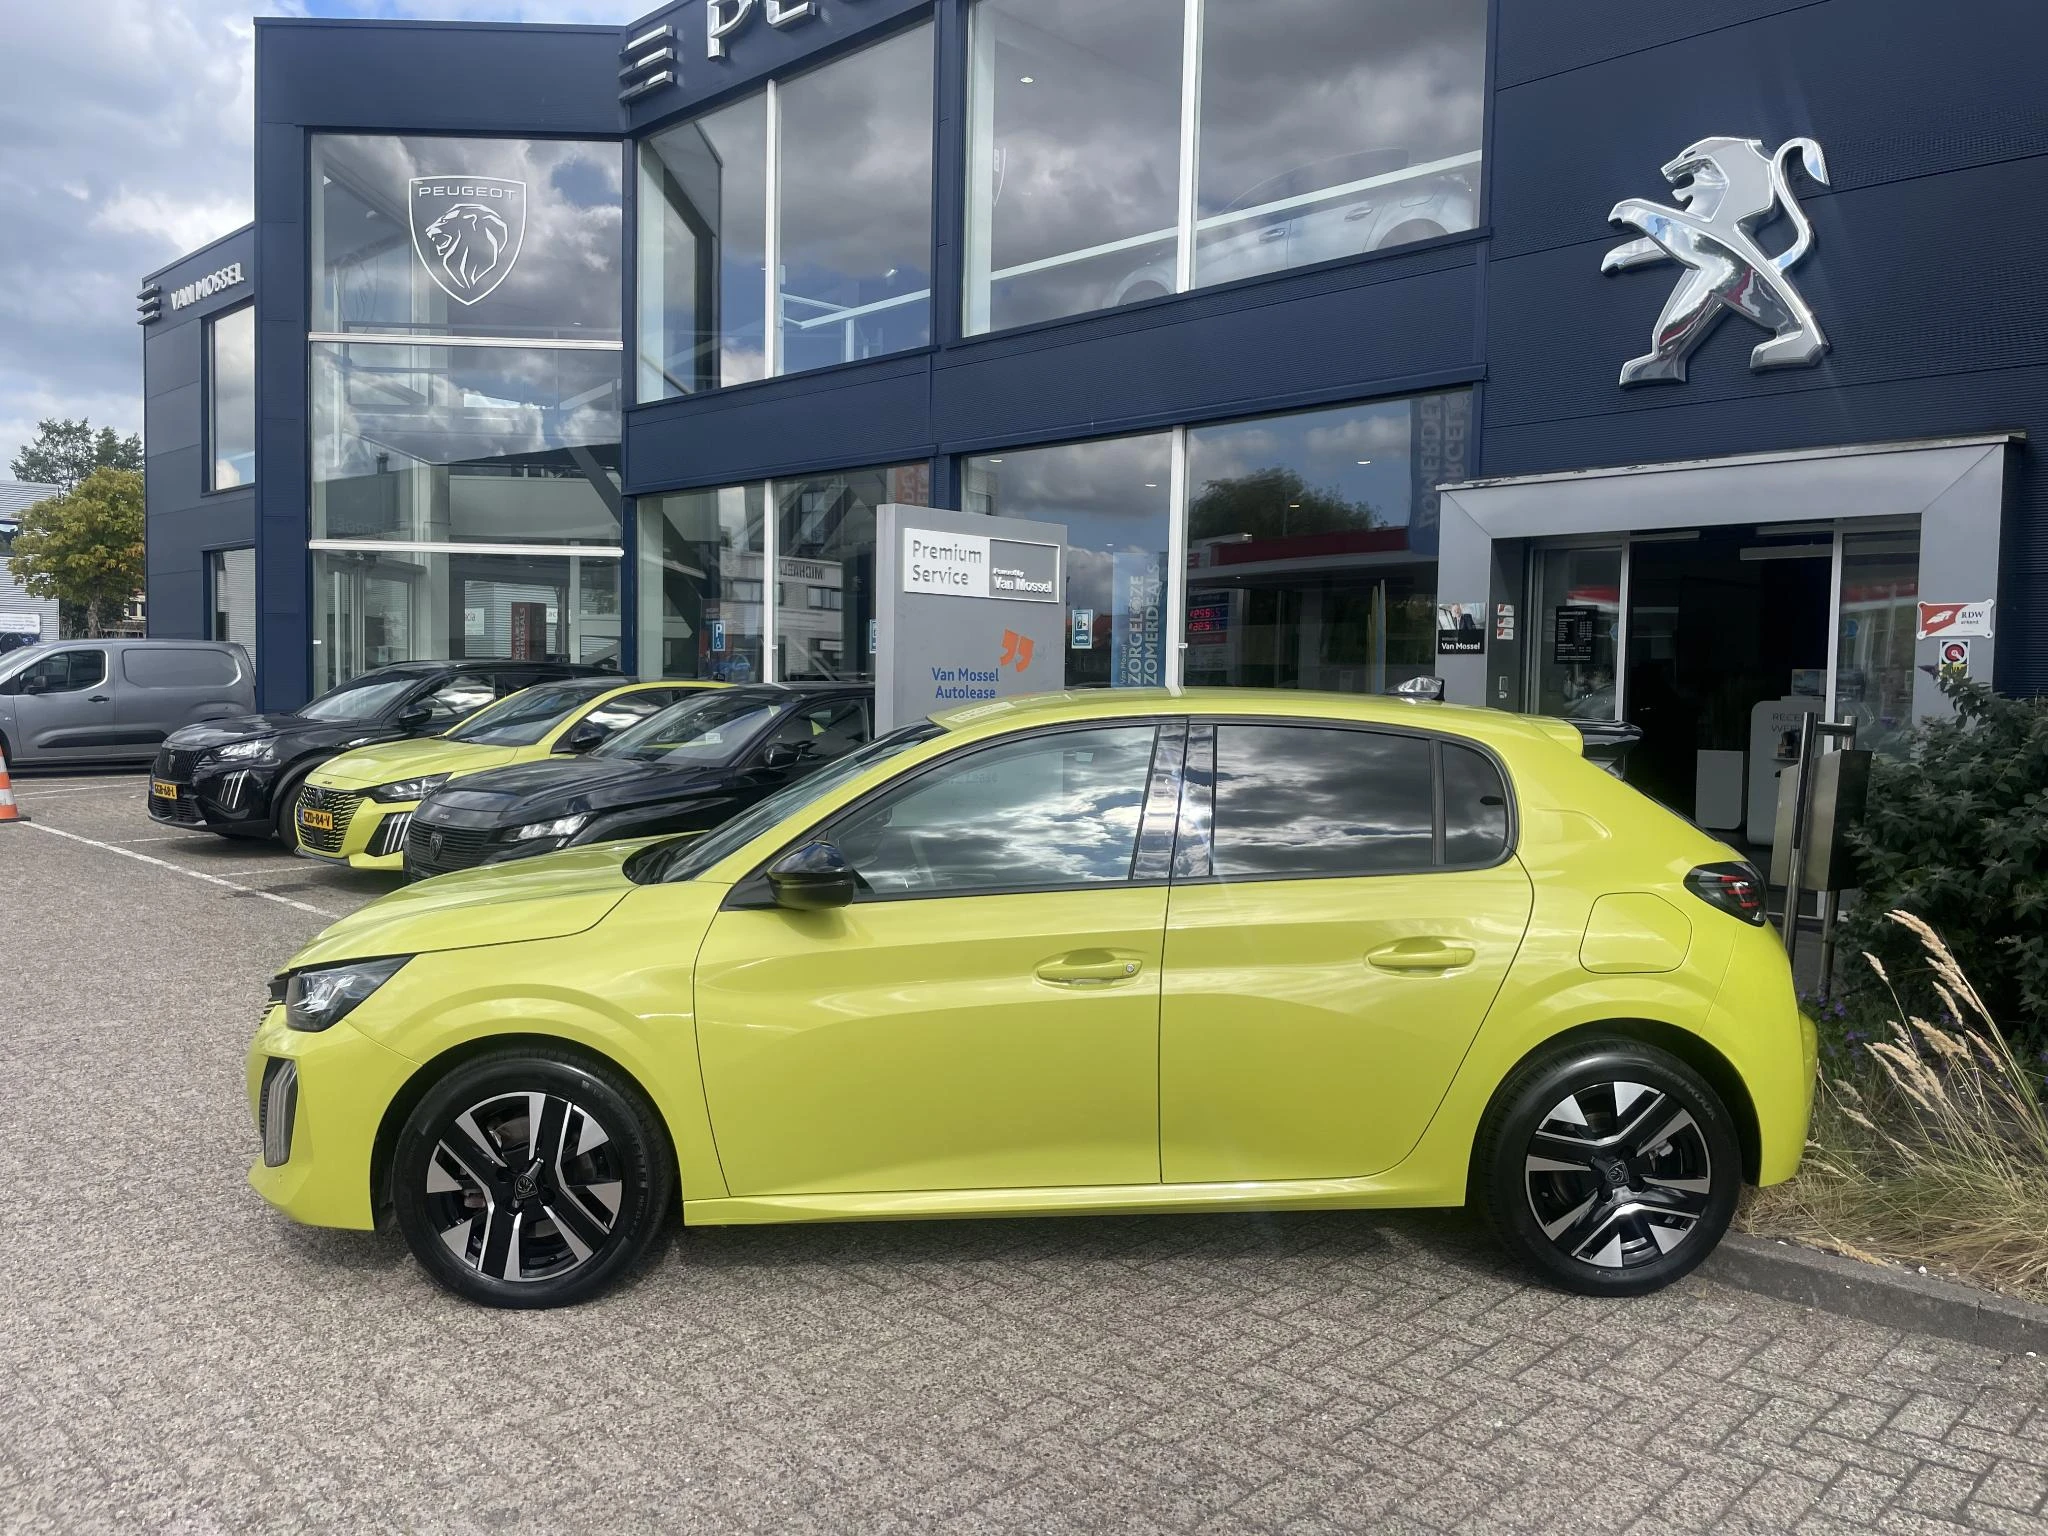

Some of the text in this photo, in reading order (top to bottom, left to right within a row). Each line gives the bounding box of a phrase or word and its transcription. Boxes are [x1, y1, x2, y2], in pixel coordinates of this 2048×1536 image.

[419, 186, 516, 200] PEUGEOT
[171, 262, 245, 311] VAN MOSSEL
[912, 539, 982, 563] Premium
[912, 564, 969, 585] Service
[994, 576, 1053, 593] Van Mossel
[1144, 562, 1161, 685] ZOMERDEALS
[1961, 611, 1984, 619] RDW
[1127, 575, 1144, 685] ZORGELOZE
[1441, 642, 1480, 650] Van Mossel
[932, 667, 999, 682] Van Mossel
[935, 684, 996, 699] Autolease
